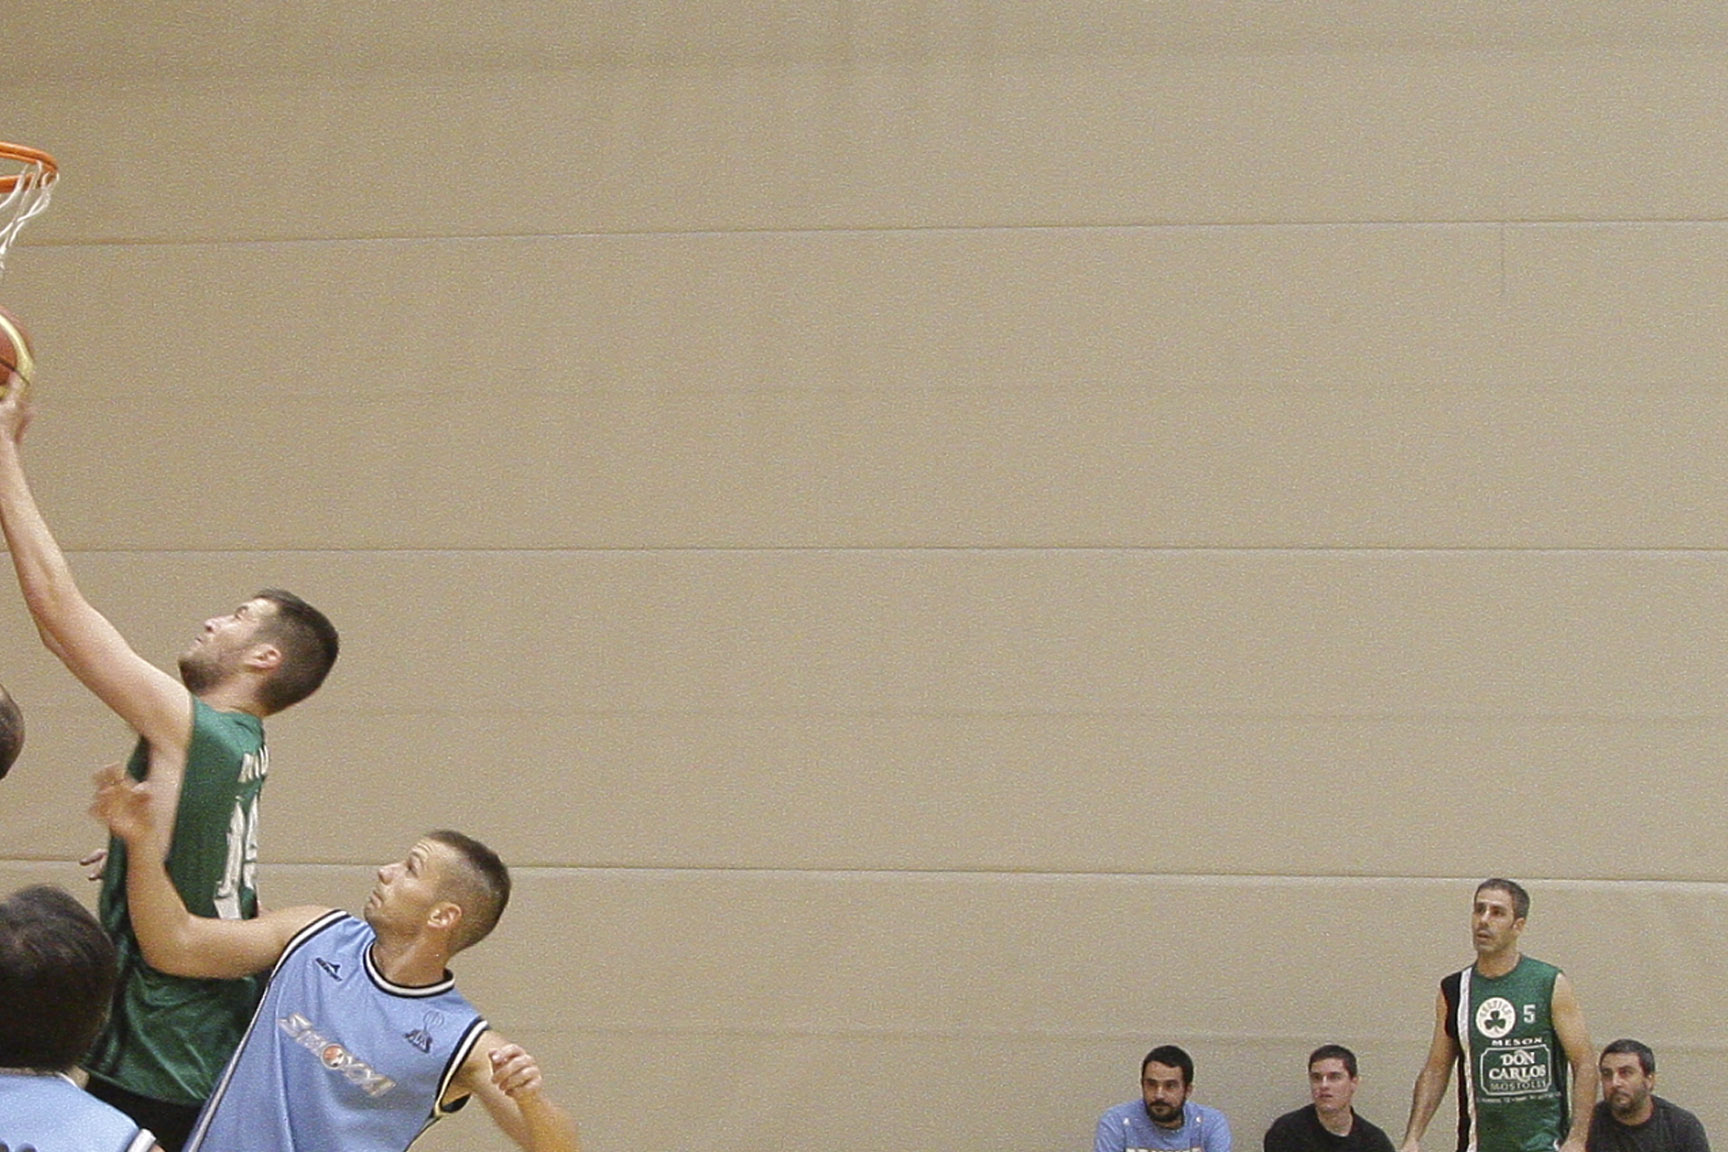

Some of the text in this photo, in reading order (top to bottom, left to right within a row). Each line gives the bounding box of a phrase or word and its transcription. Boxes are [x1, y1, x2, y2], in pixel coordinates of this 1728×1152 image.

[1523, 1003, 1536, 1024] 5
[1500, 1049, 1535, 1066] DON
[1488, 1064, 1547, 1082] CARLOS
